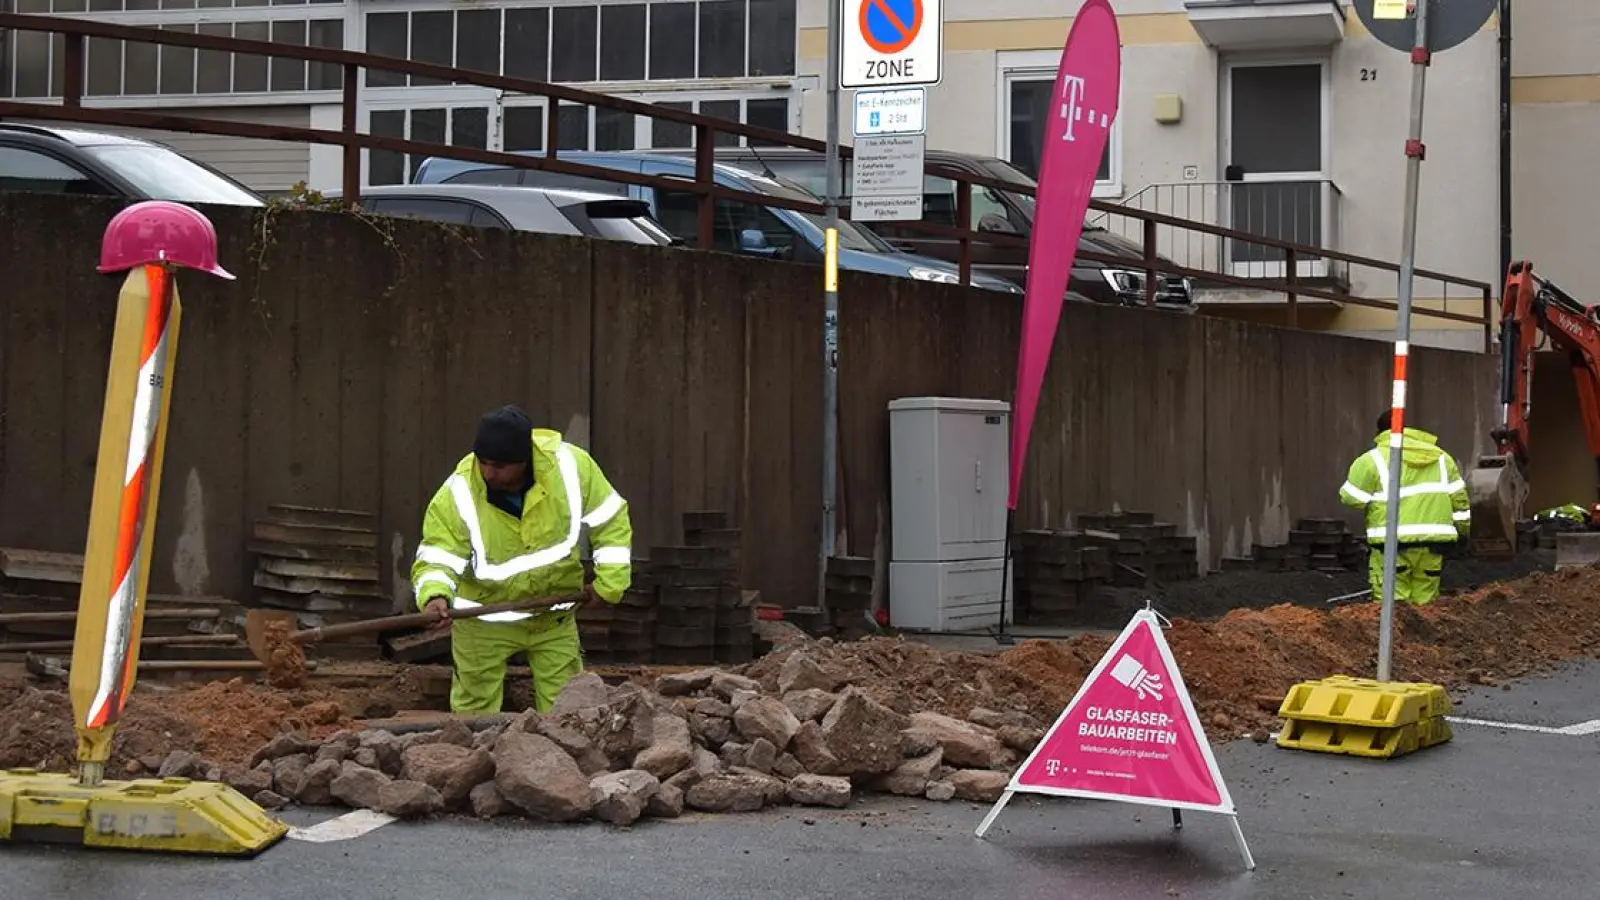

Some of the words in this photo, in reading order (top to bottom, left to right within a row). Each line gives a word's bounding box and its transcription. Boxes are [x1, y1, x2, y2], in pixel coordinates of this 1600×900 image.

[866, 58, 914, 79] ZONE
[1360, 68, 1377, 81] 21
[889, 113, 895, 123] 2
[1086, 706, 1174, 727] GLASFASER-
[1078, 722, 1177, 744] BAUARBEITEN
